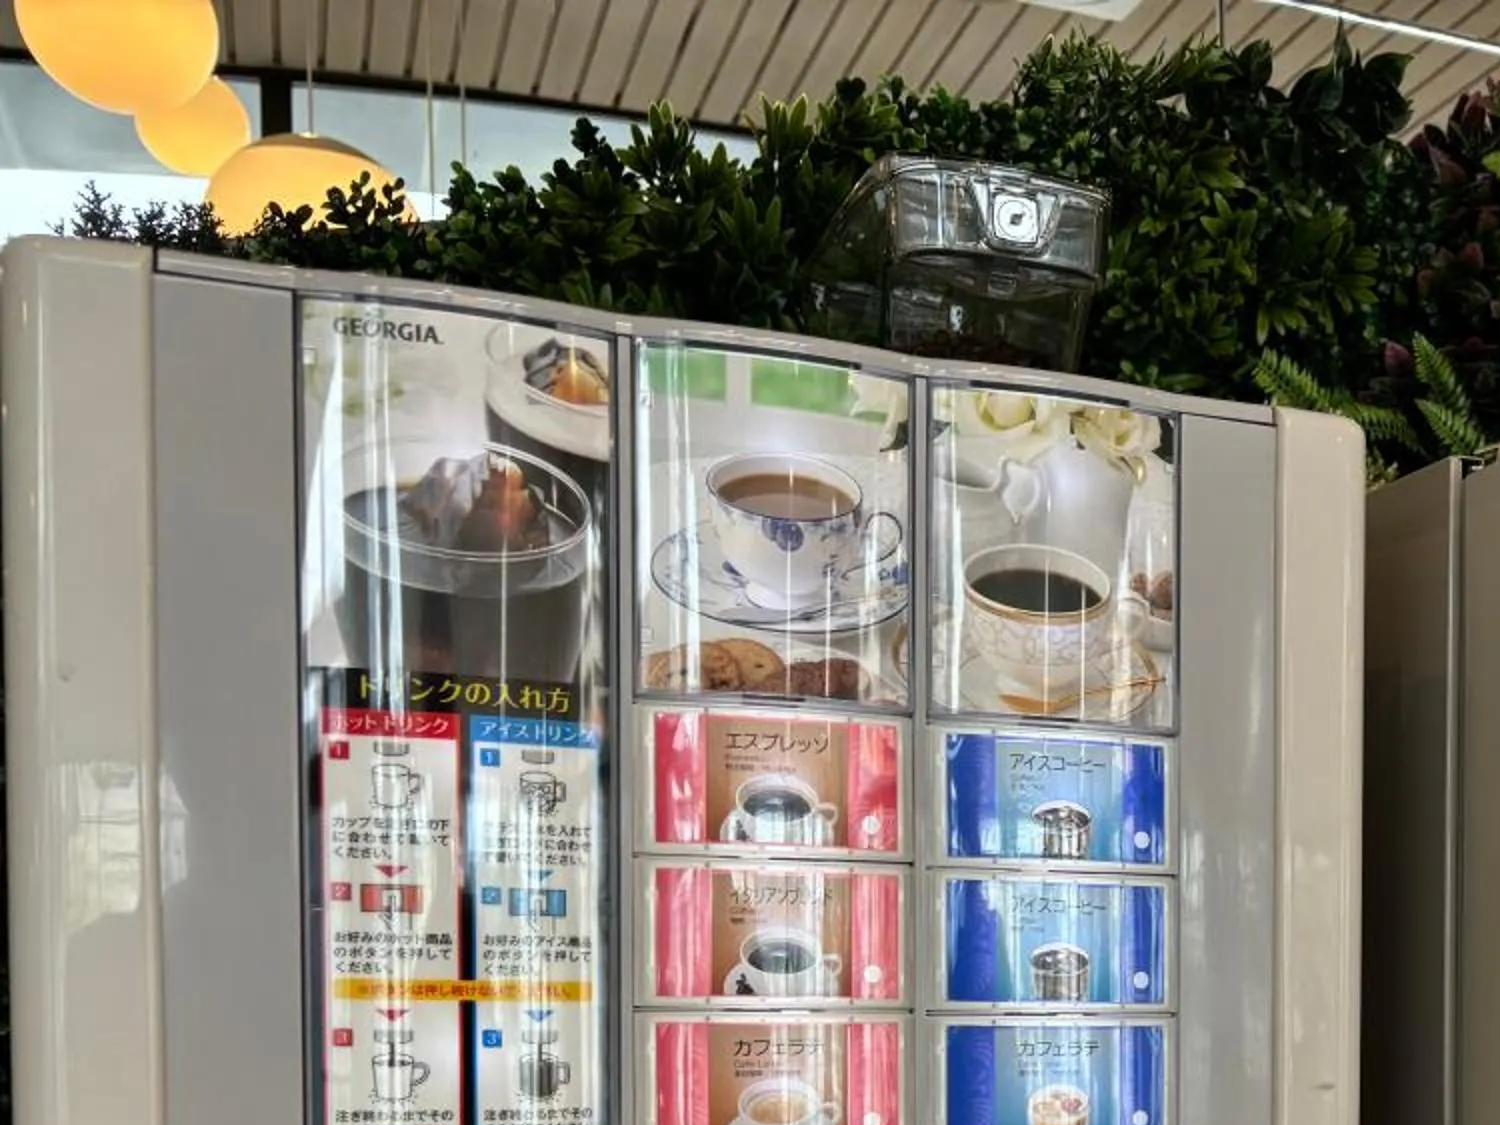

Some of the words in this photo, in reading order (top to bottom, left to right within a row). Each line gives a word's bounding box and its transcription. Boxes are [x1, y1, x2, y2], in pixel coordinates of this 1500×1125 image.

[333, 316, 439, 345] GEORGIA
[725, 732, 829, 755] エスプレッソ
[1009, 752, 1106, 774] アイスコーヒー
[730, 886, 833, 906] イタリアンブド
[734, 1039, 825, 1058] カフェラテ
[1018, 1040, 1100, 1058] カフェラテ
